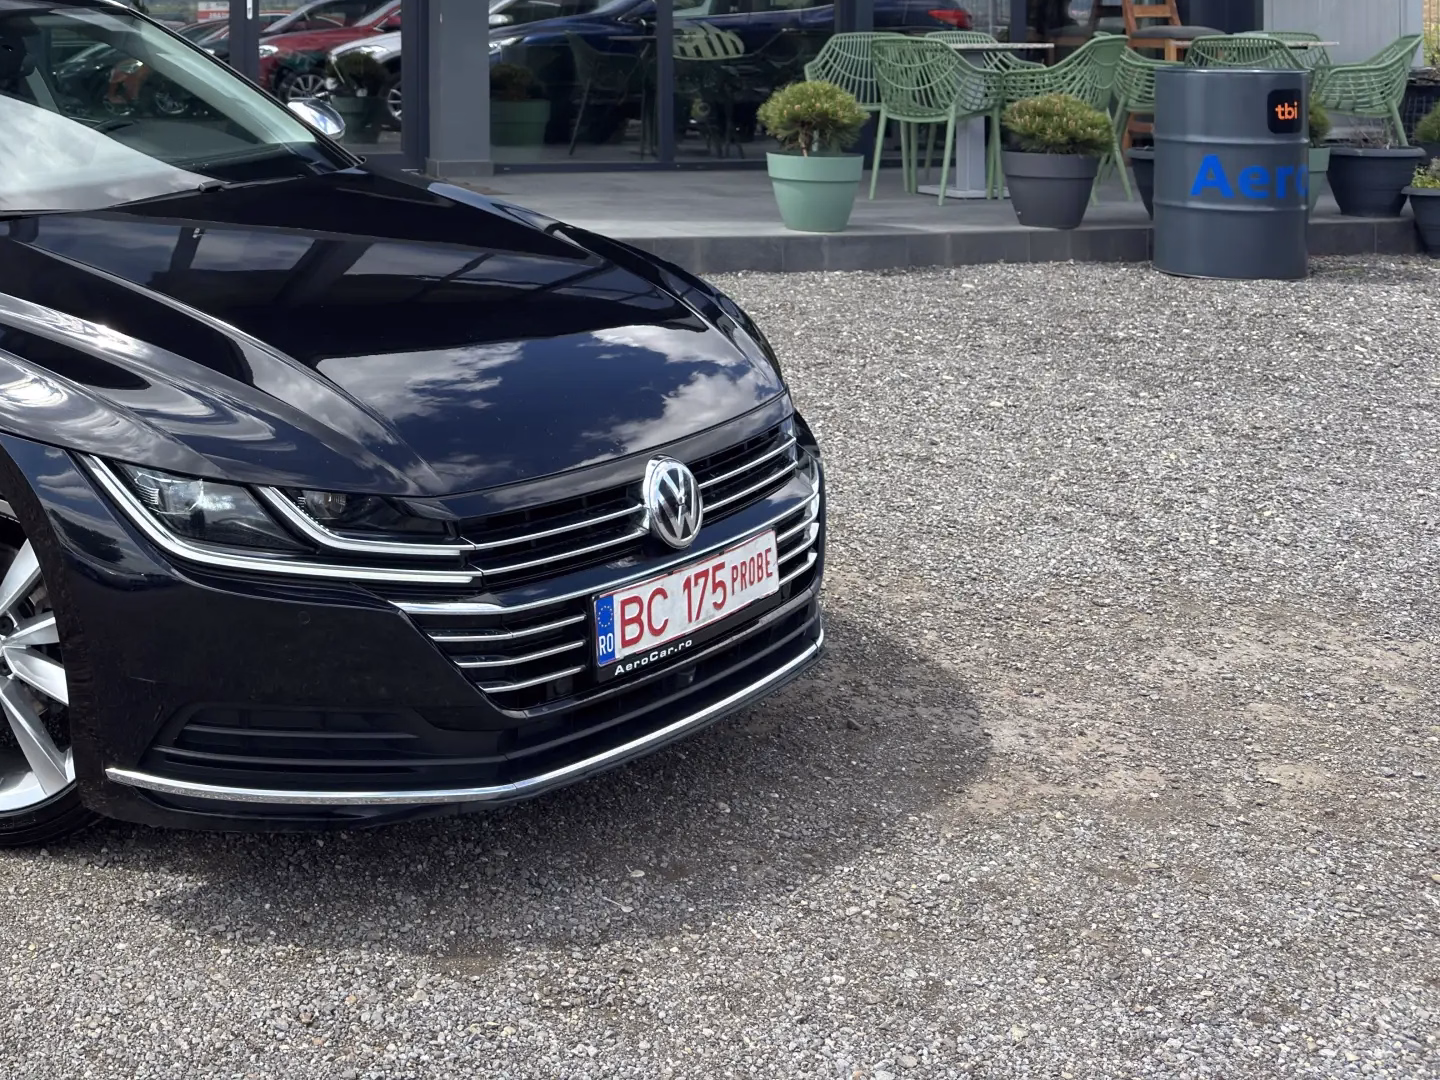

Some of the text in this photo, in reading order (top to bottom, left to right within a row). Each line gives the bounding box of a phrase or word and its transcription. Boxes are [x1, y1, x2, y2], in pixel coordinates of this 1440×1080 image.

[1275, 101, 1298, 120] tbi
[619, 548, 774, 649] BC 175 PROBE
[599, 634, 615, 657] RO
[614, 638, 693, 676] AeroCar.ro
